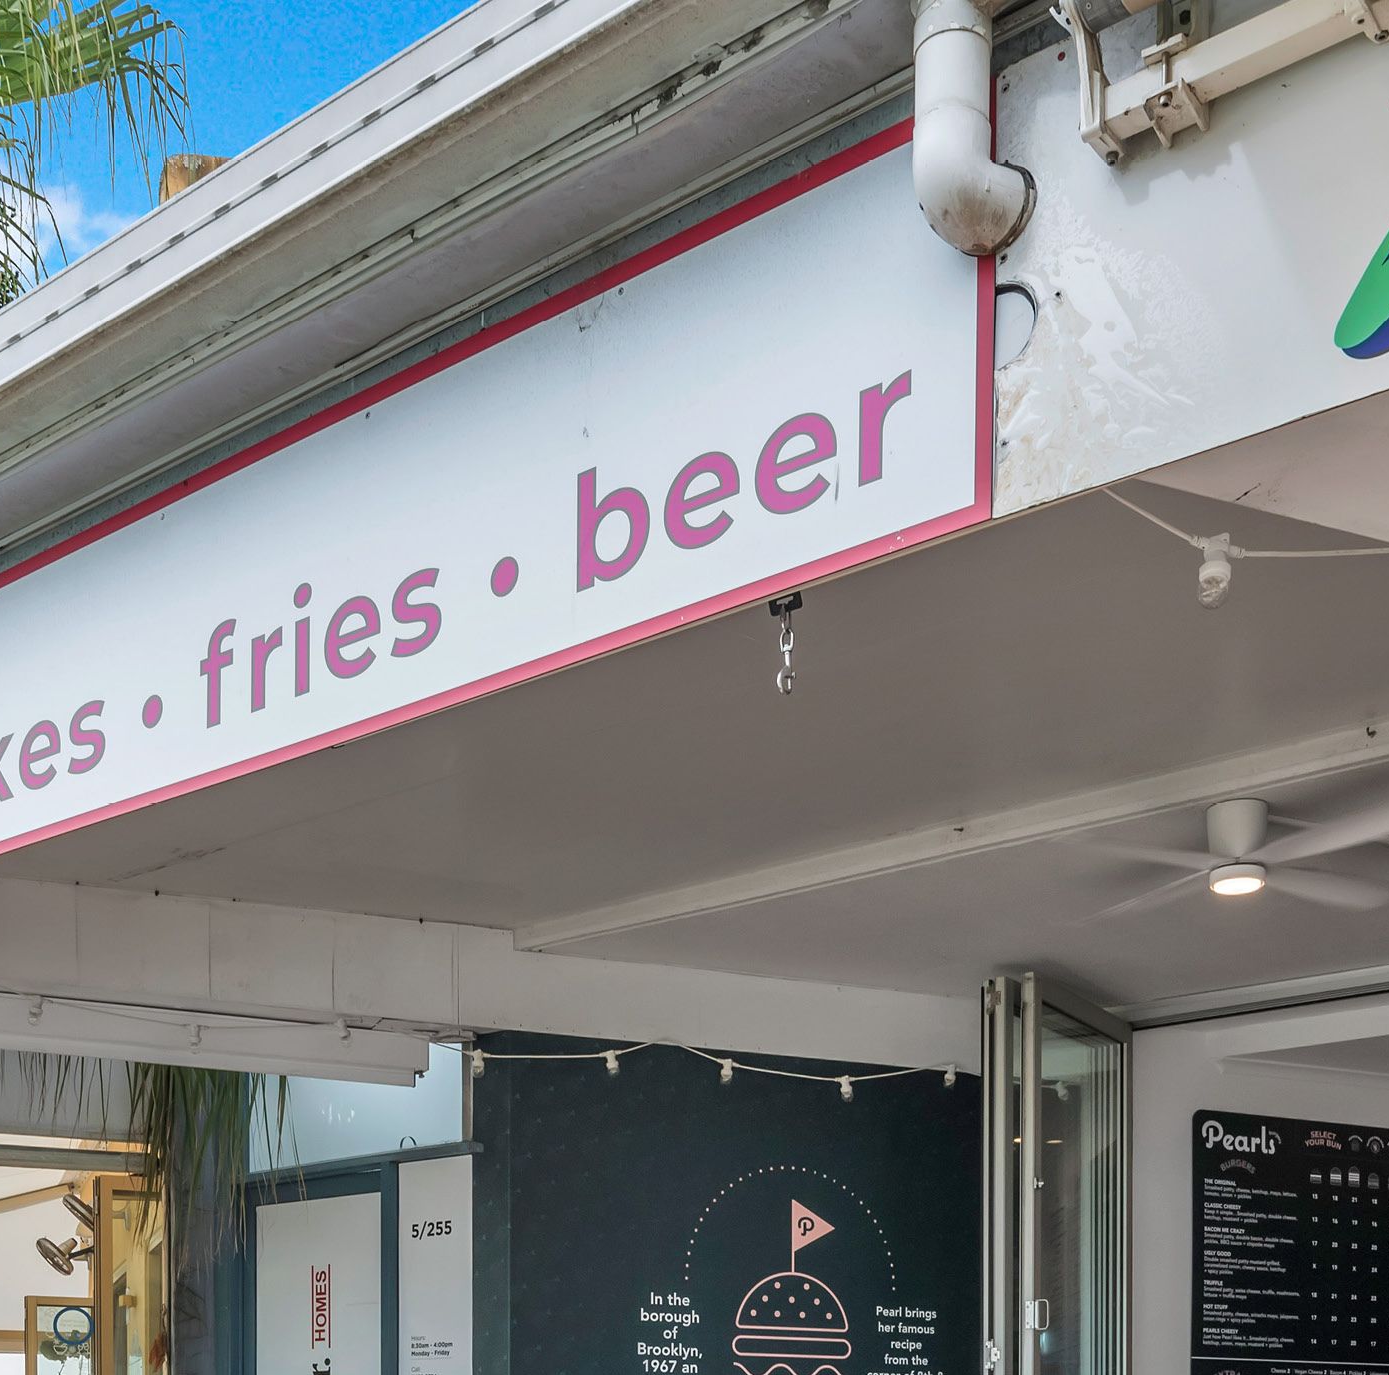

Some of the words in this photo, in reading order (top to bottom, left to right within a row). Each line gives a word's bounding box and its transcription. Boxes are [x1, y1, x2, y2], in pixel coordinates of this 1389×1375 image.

[199, 566, 442, 729] fries
[575, 368, 913, 593] beer
[1202, 1120, 1275, 1154] Pearls
[1310, 1131, 1337, 1140] SELECT
[1305, 1138, 1326, 1147] YOUR
[1326, 1139, 1341, 1150] BUN
[1220, 1159, 1256, 1174] BURGERS
[1214, 1179, 1236, 1187] ORIGINAL
[411, 1220, 452, 1240] 5/255
[314, 1270, 327, 1342] HOMES
[651, 1292, 662, 1305] In
[667, 1292, 690, 1306] the
[640, 1307, 699, 1327] borough
[876, 1306, 902, 1317] Pearl
[905, 1306, 937, 1321] brings
[663, 1326, 678, 1339] of
[877, 1321, 895, 1333] her
[897, 1322, 935, 1335] famous
[433, 1341, 453, 1349] 4:00pm
[637, 1342, 703, 1360] Brooklyn,
[890, 1339, 922, 1352] recipe
[642, 1359, 677, 1373] 1967
[681, 1363, 698, 1374] an
[884, 1353, 909, 1365] from
[911, 1354, 929, 1366] the
